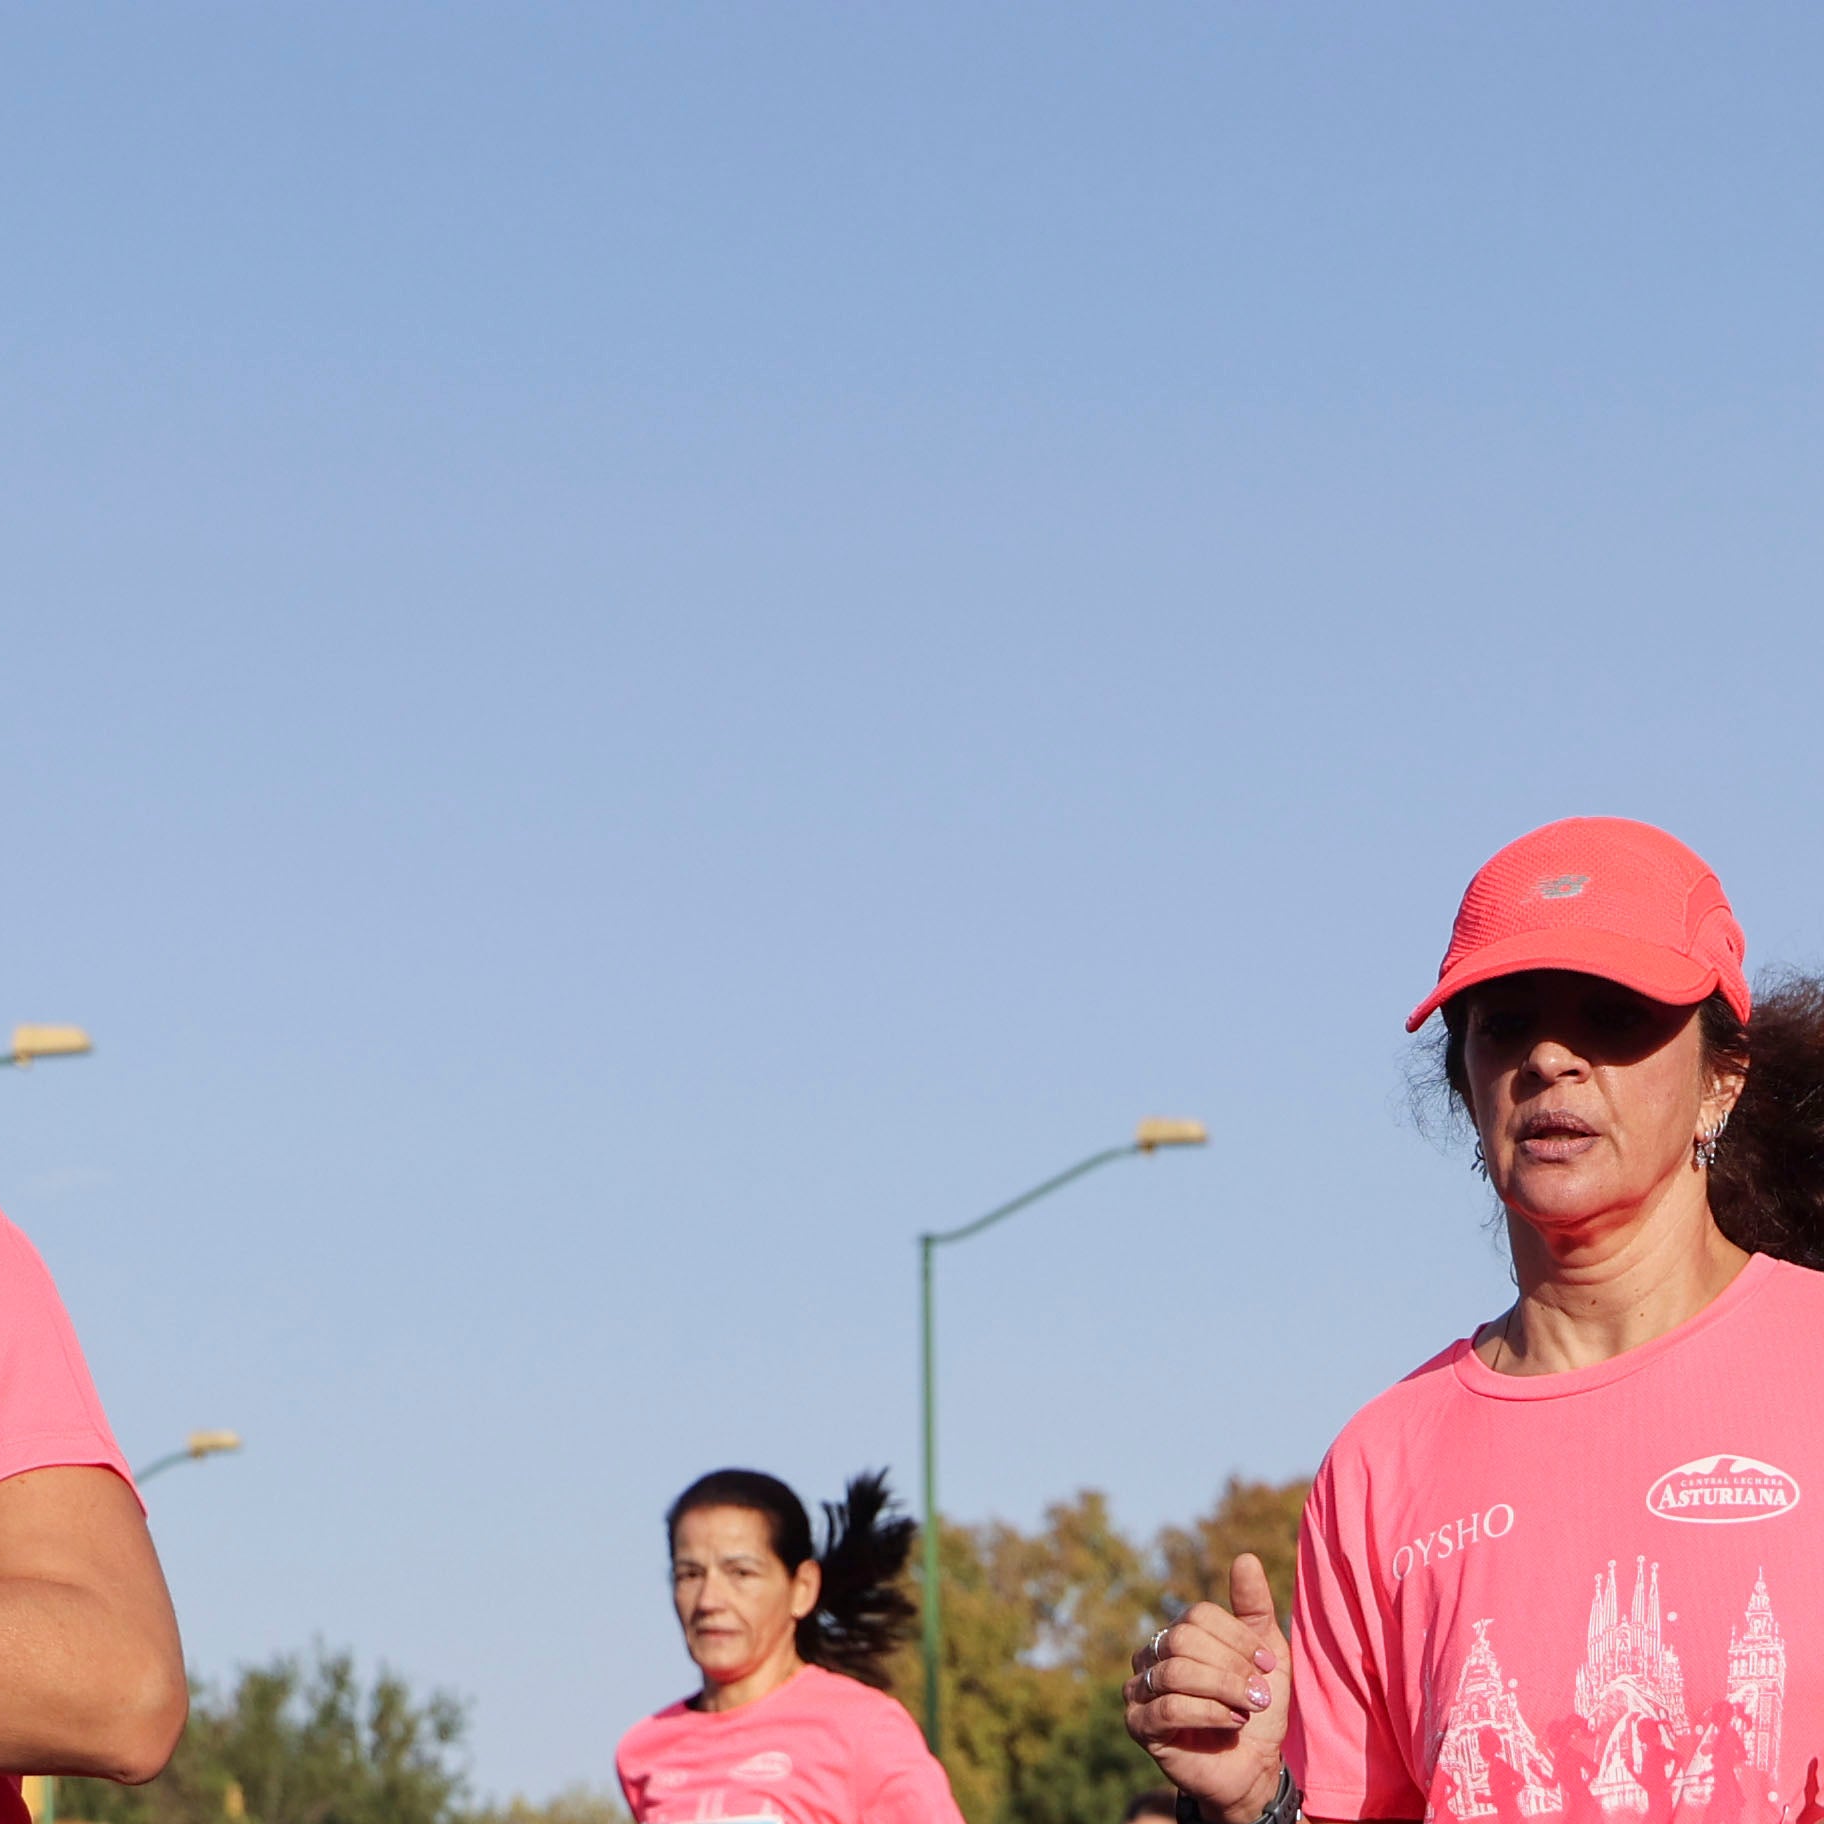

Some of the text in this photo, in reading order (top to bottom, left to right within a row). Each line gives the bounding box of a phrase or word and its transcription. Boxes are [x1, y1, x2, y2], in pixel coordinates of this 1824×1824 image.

[1680, 1476, 1783, 1487] CENTRAL LECHERA
[1657, 1483, 1788, 1510] ASTURIANA
[1392, 1503, 1514, 1581] OYSHO
